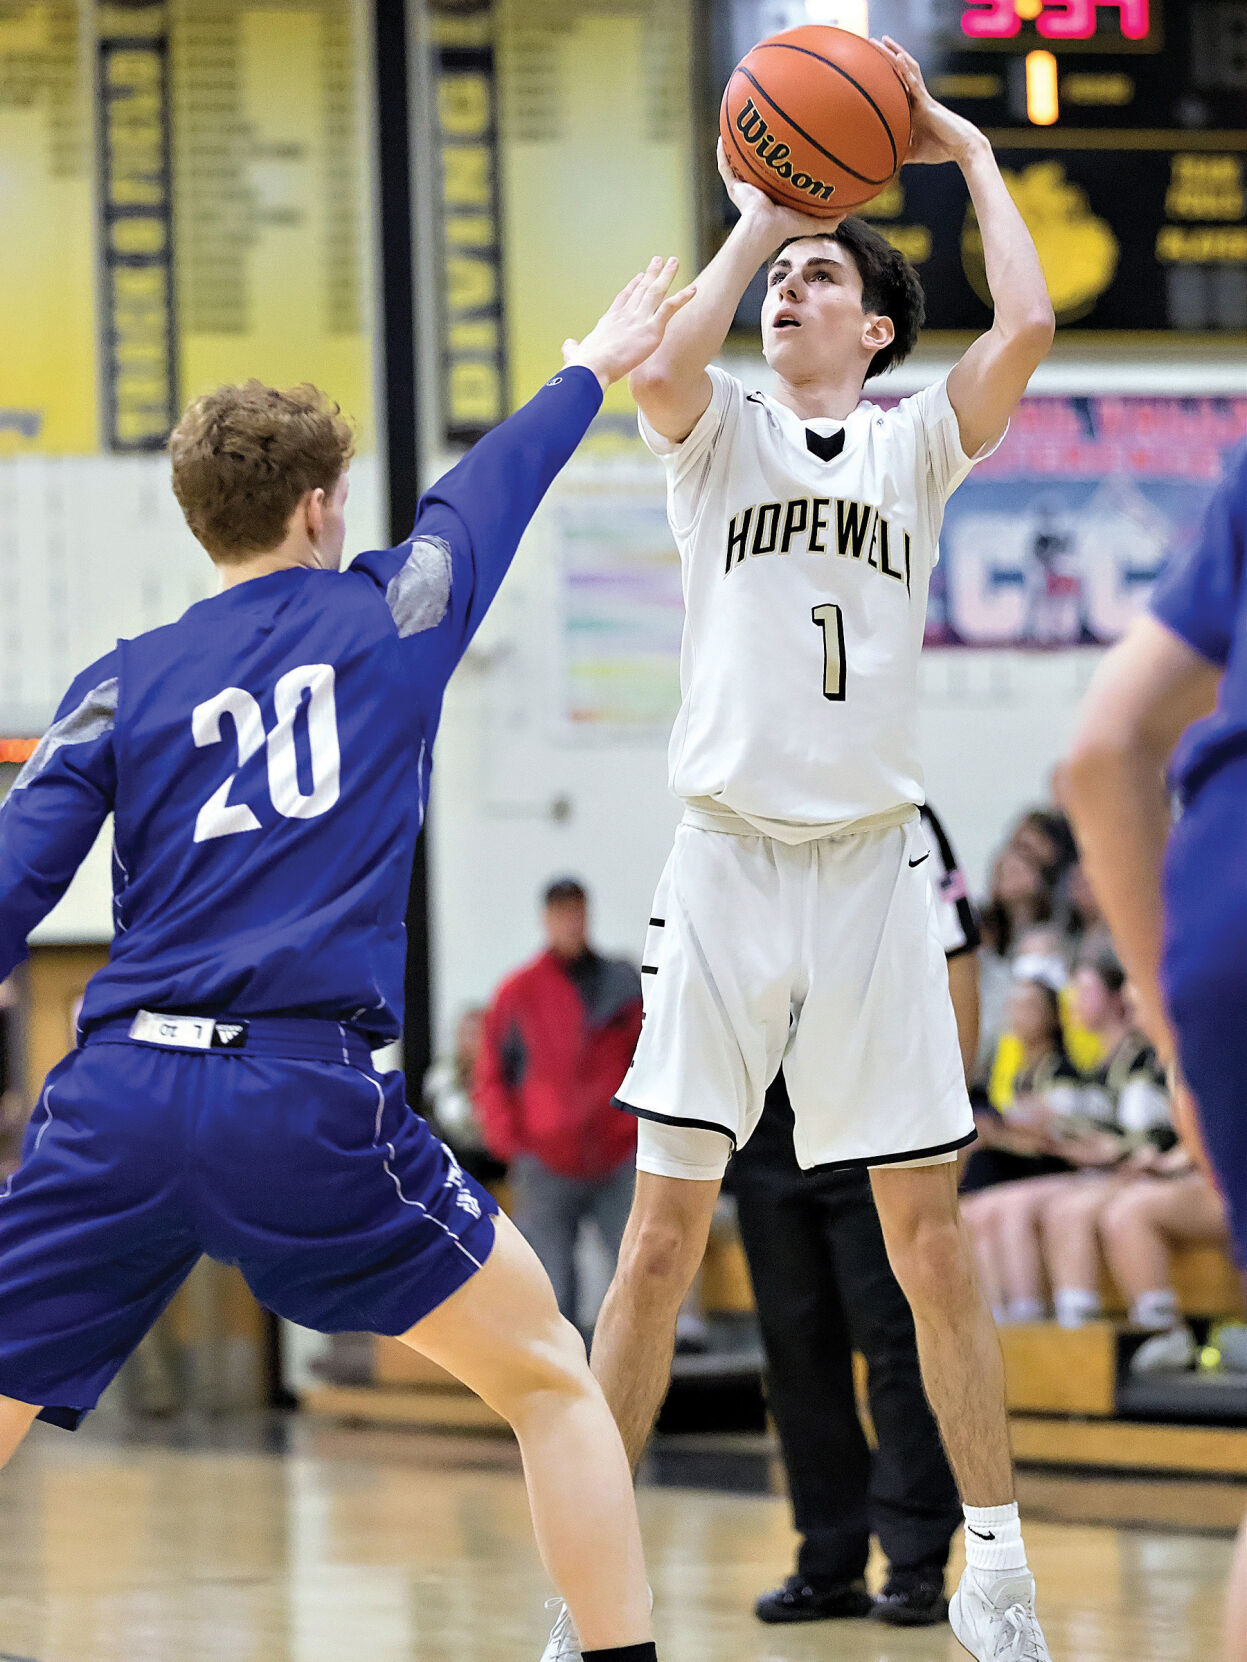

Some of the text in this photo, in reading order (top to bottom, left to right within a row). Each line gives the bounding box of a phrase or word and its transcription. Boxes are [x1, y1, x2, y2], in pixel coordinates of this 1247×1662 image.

[736, 96, 836, 201] Wilson
[437, 73, 498, 425] DIVING
[811, 603, 847, 702] 1
[191, 663, 341, 844] 20
